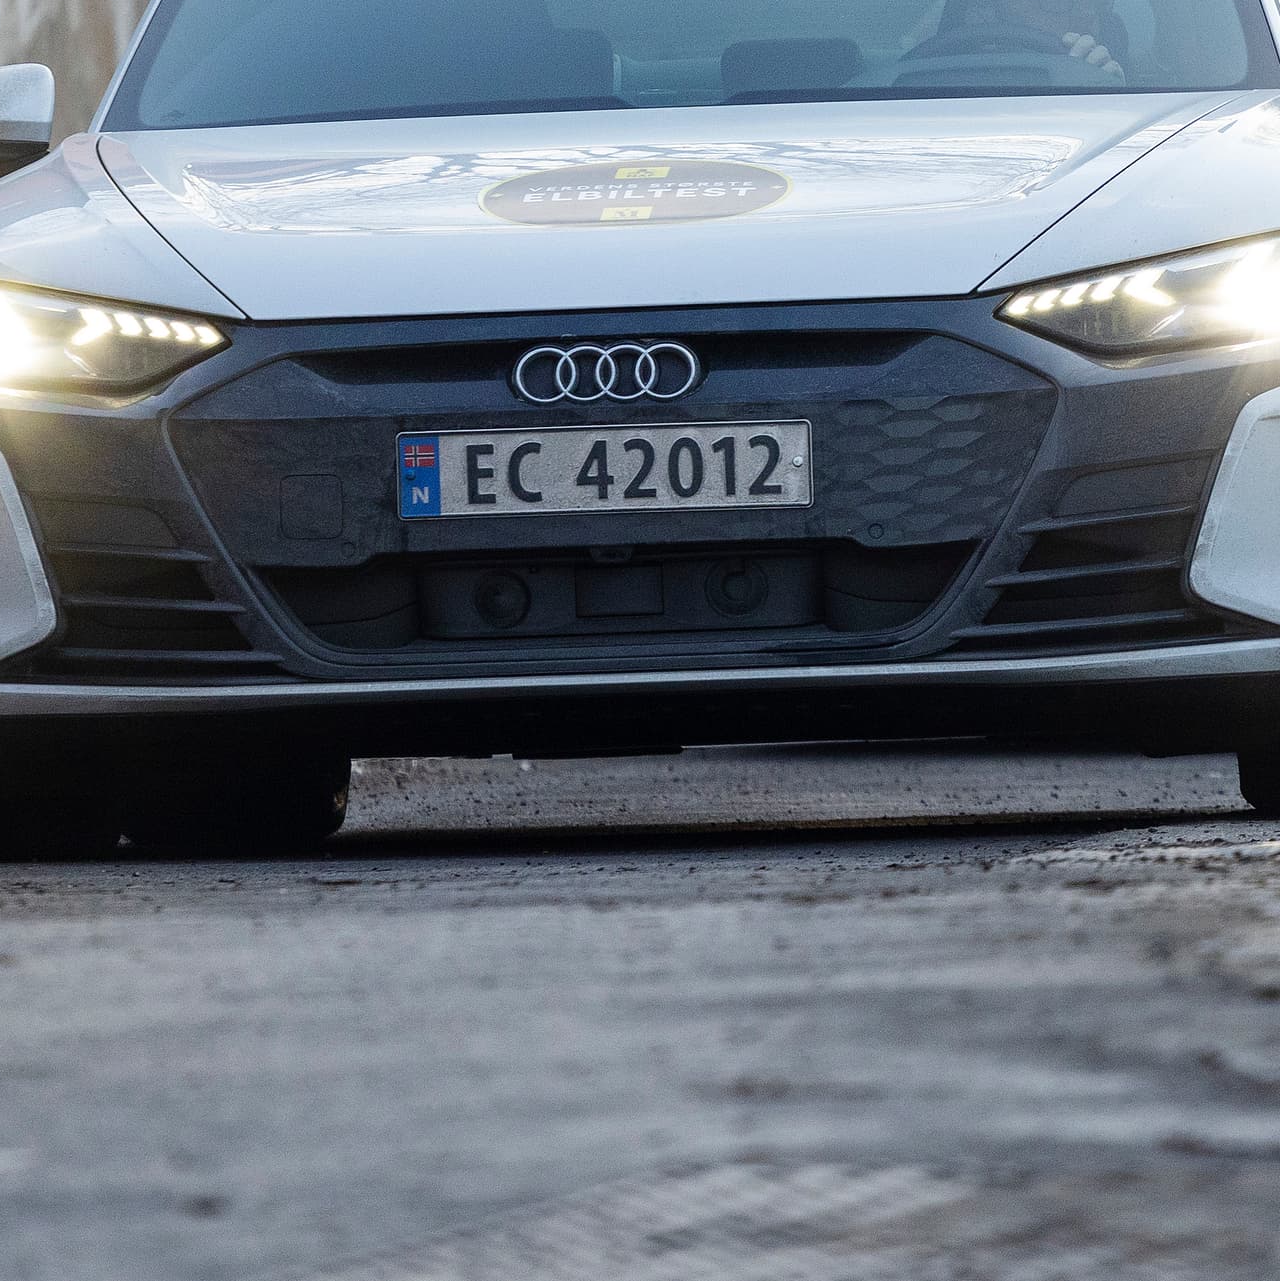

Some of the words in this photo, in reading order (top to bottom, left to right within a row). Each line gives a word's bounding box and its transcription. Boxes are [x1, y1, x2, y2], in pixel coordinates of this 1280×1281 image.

[523, 187, 757, 203] ELBILTEST
[528, 183, 638, 192] VERDENS
[650, 180, 754, 188] STØRSTE
[466, 442, 542, 505] EC
[576, 435, 783, 500] 42012
[412, 485, 430, 505] N
